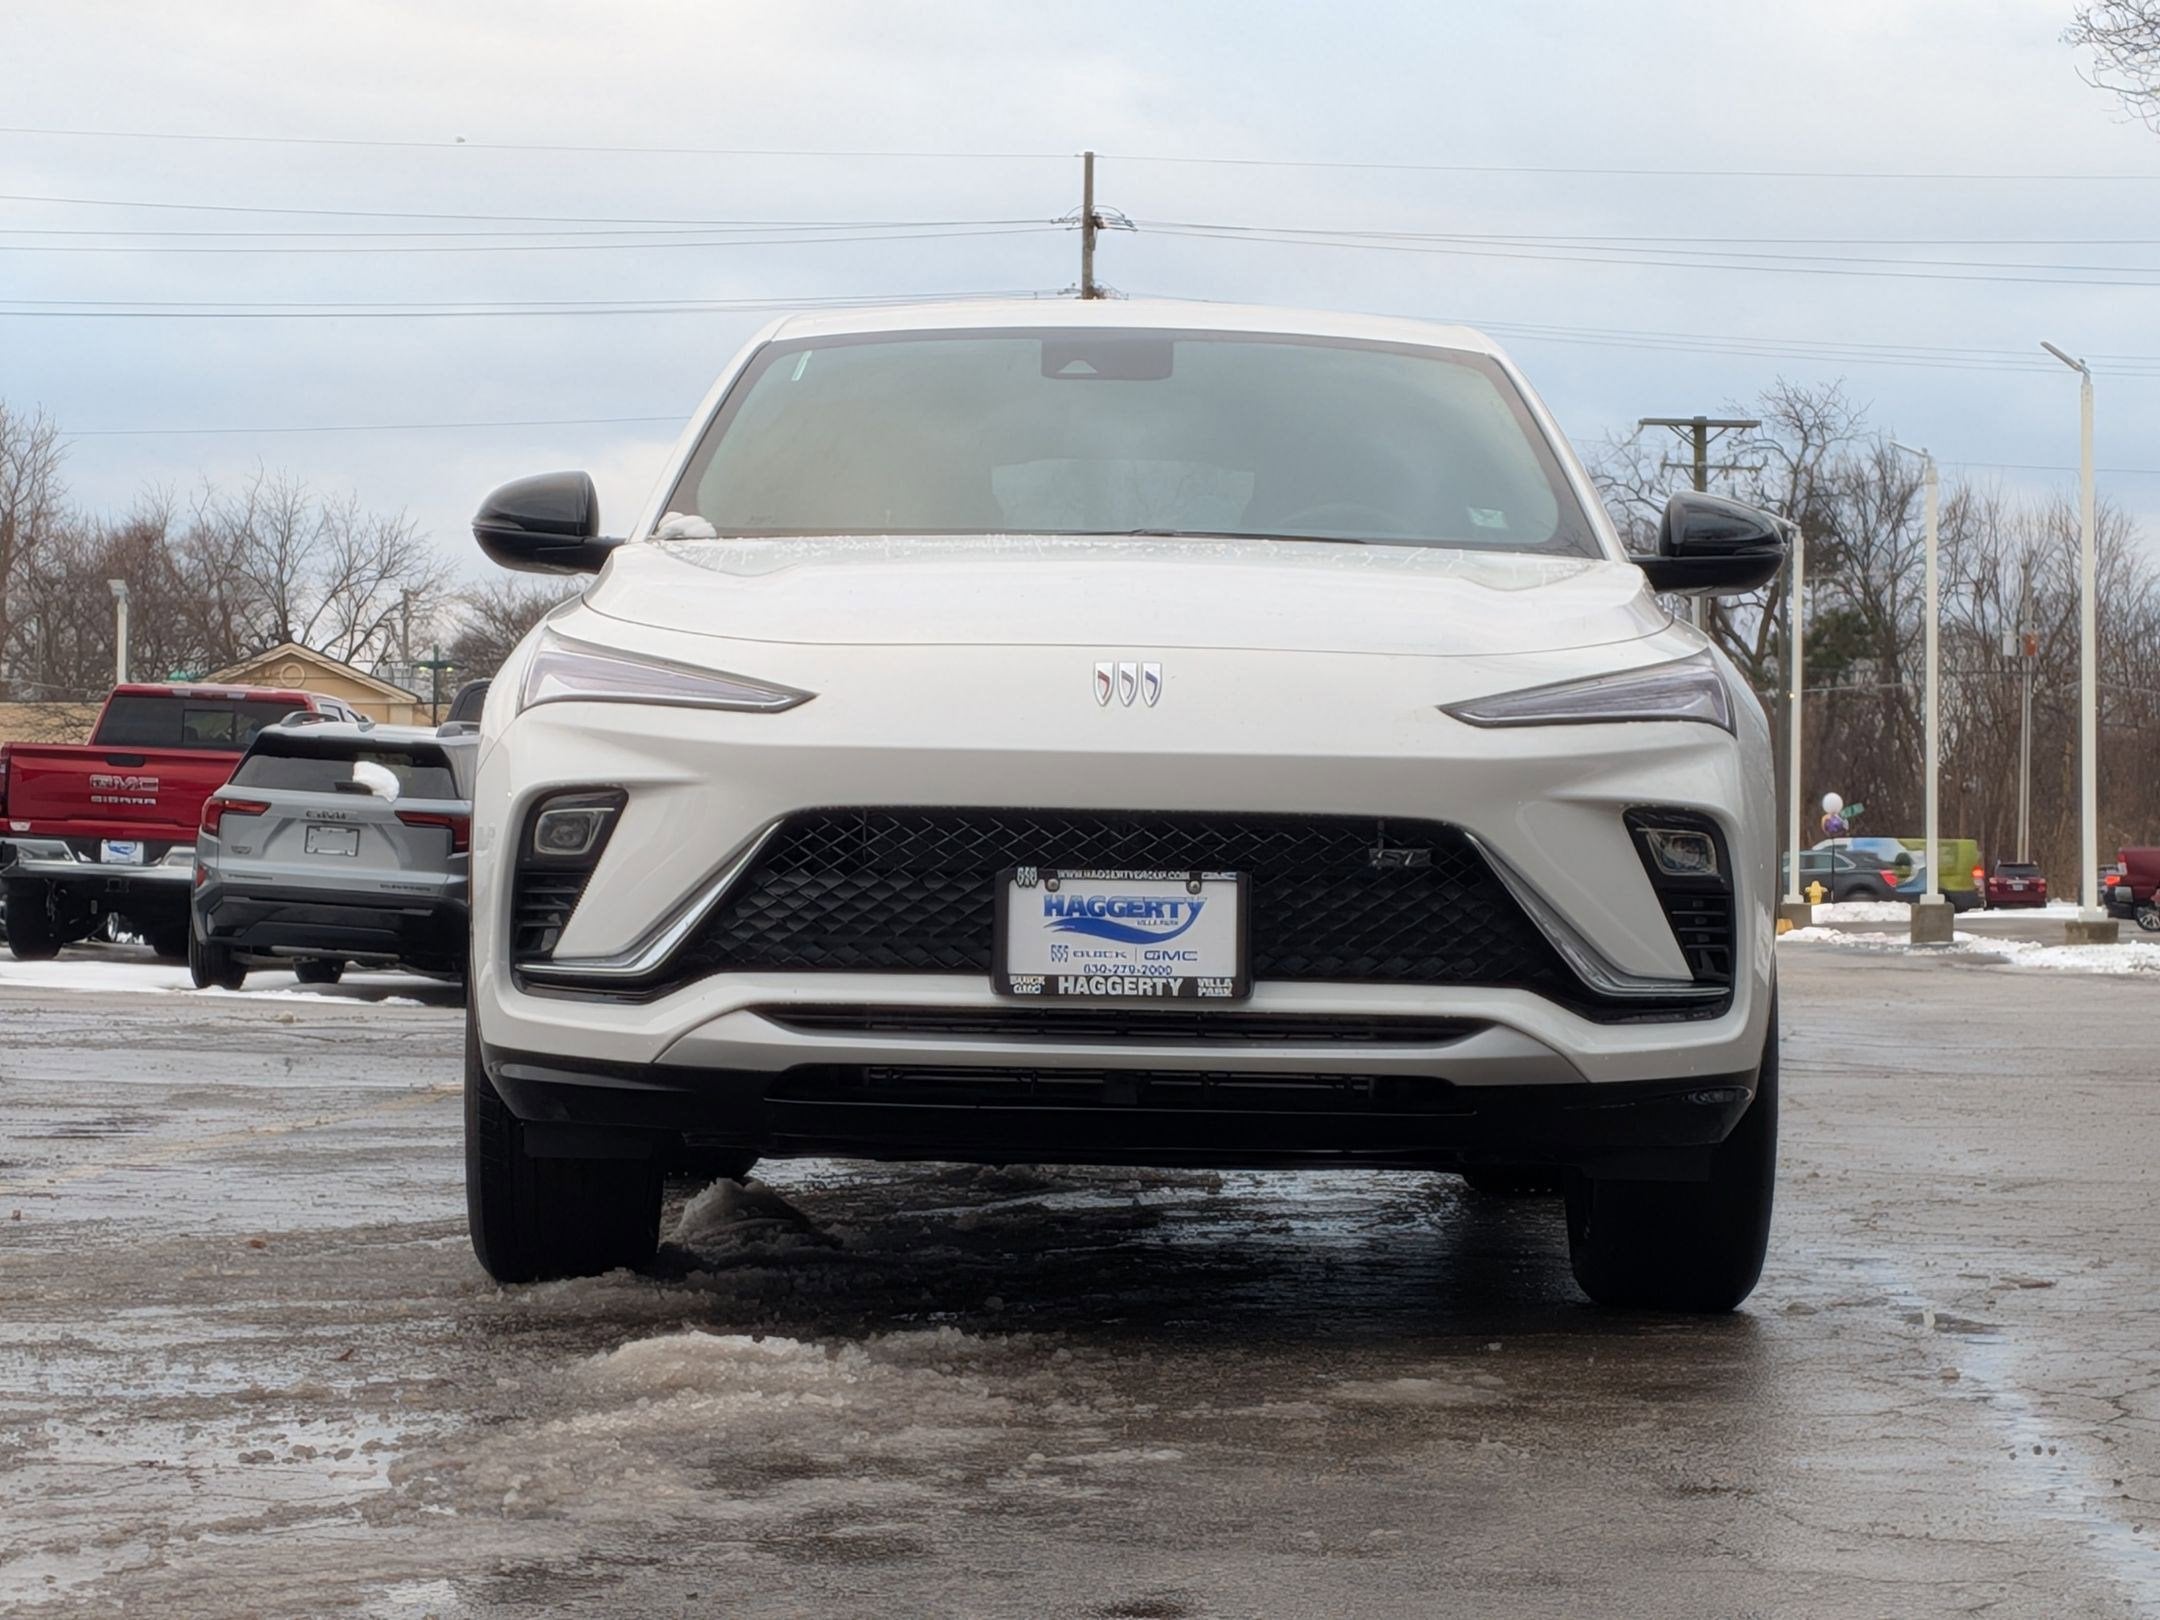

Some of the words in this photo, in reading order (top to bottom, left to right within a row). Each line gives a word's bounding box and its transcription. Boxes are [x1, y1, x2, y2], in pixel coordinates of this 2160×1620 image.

[90, 774, 159, 792] GMC
[1044, 894, 1207, 919] HAGGERTY
[1072, 951, 1128, 959] BUICK
[1144, 950, 1198, 961] GMC
[1058, 976, 1183, 996] HAGGERTY
